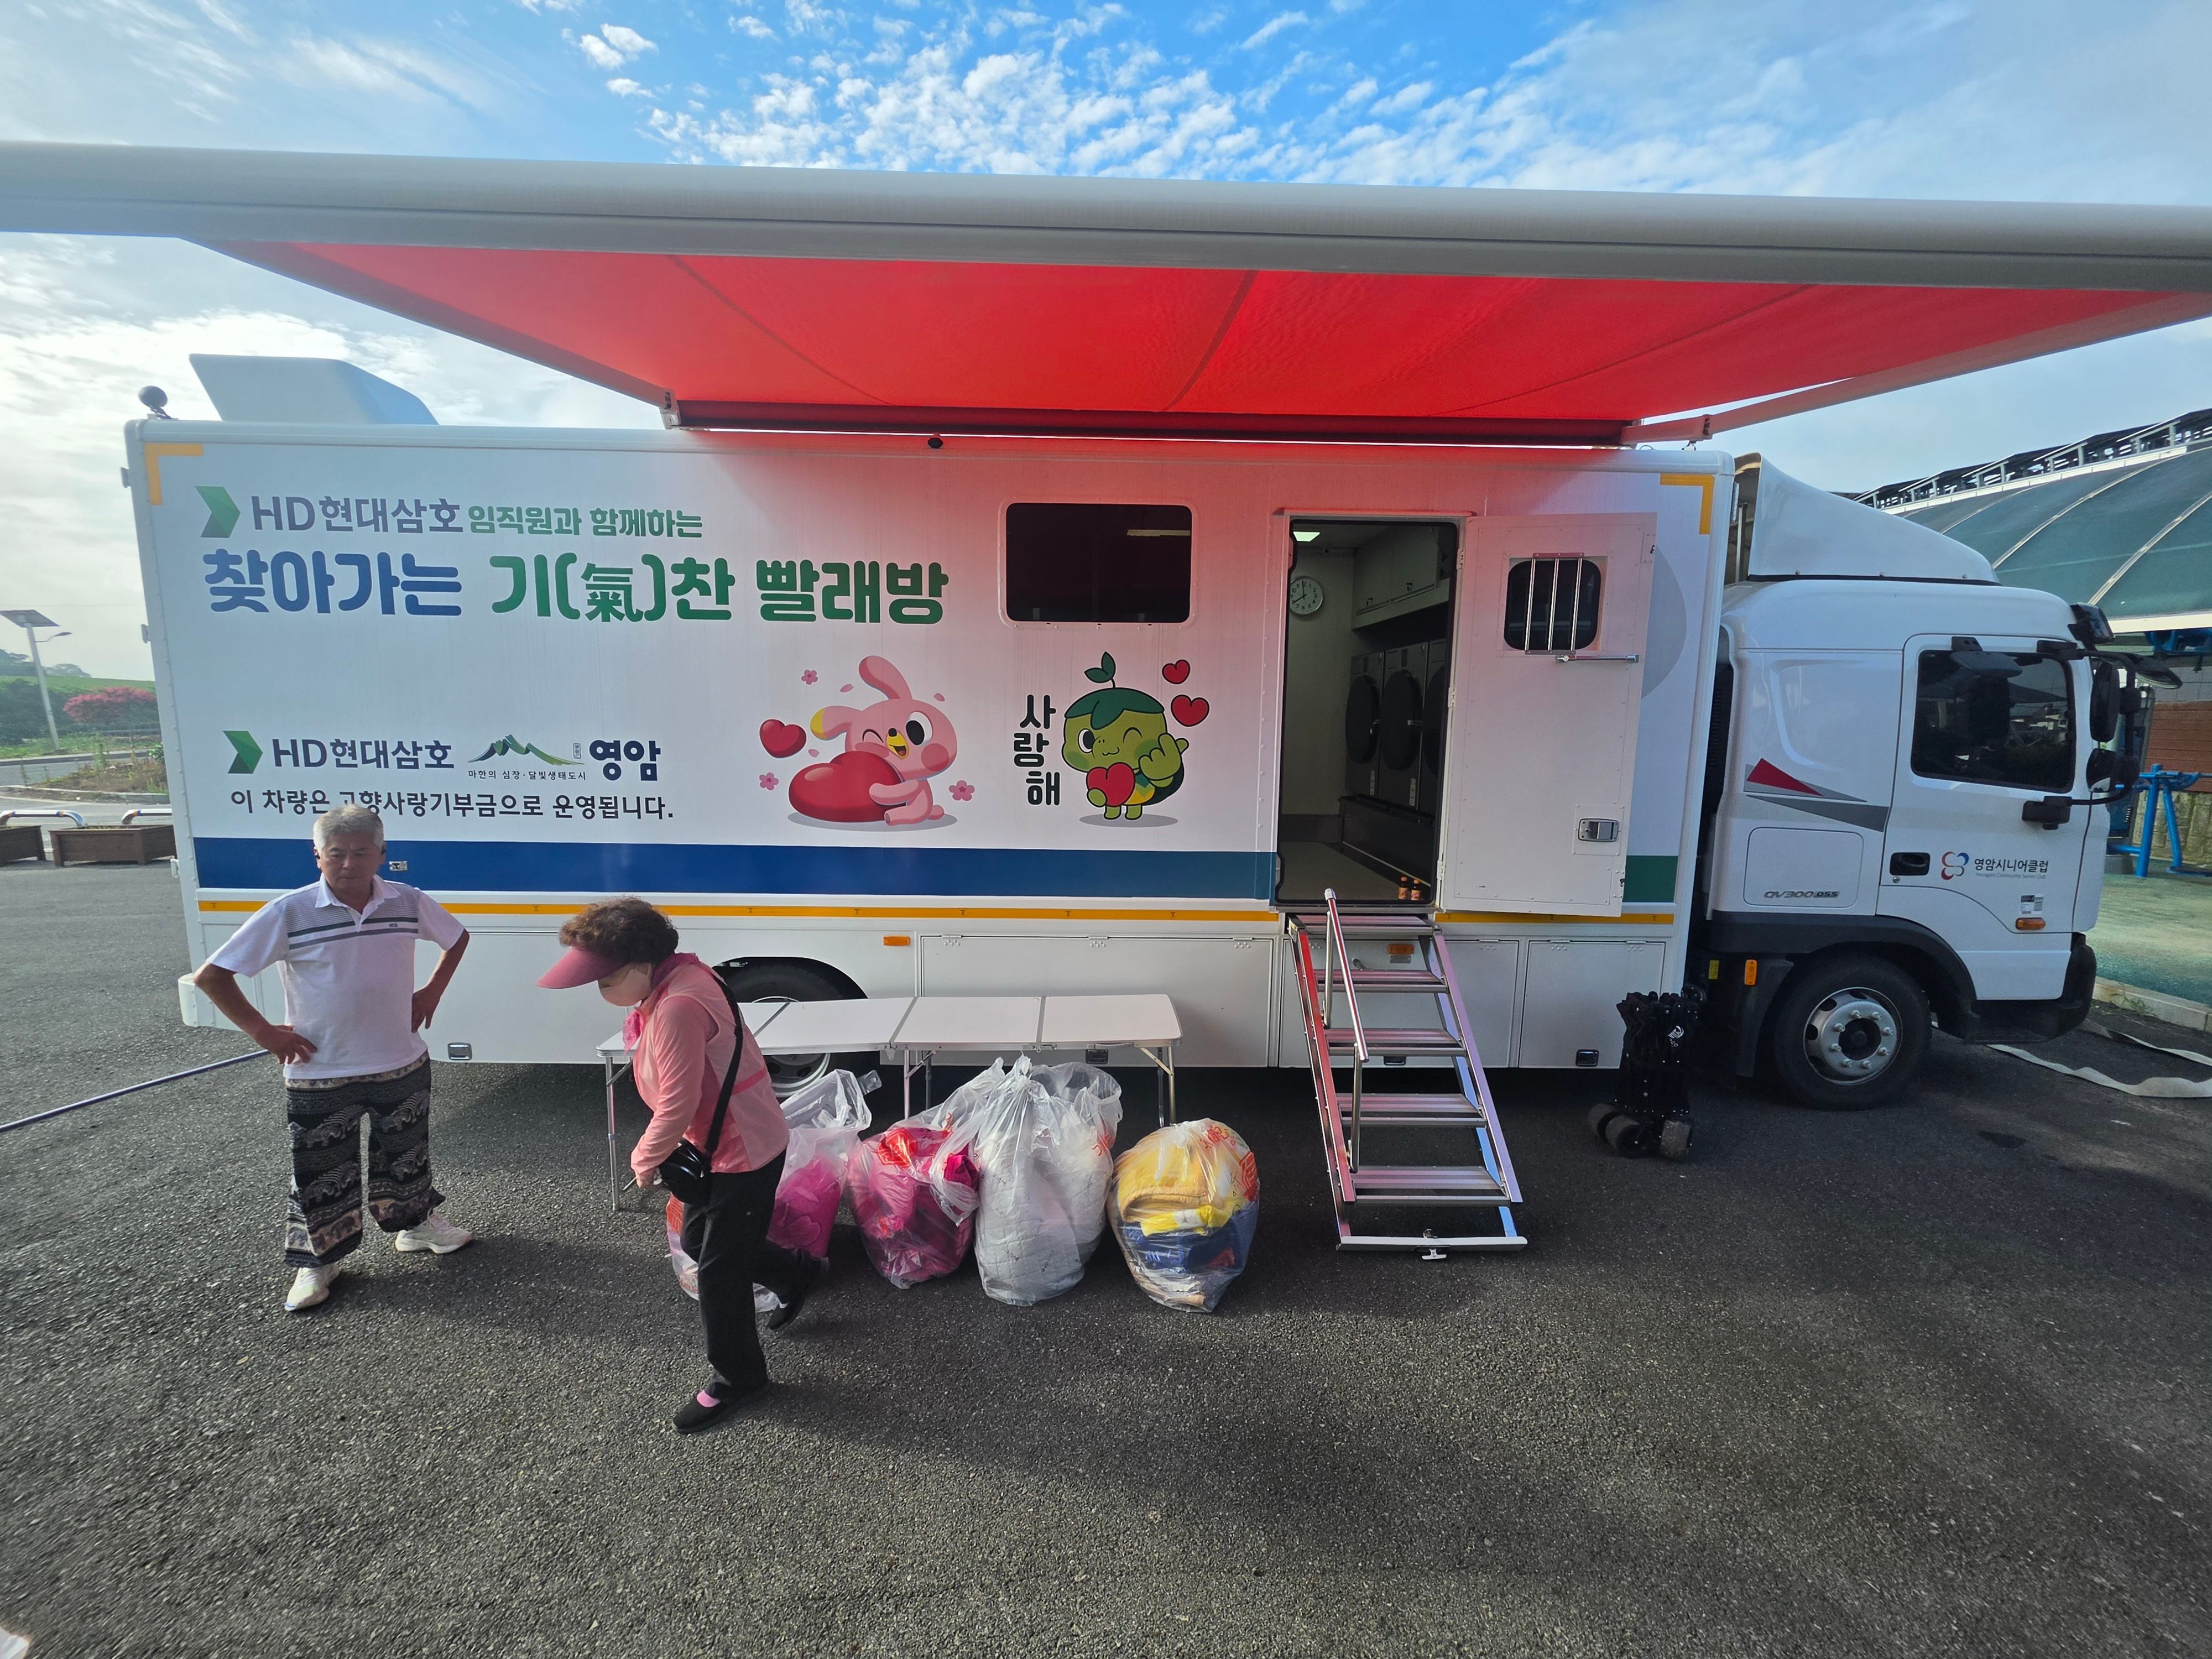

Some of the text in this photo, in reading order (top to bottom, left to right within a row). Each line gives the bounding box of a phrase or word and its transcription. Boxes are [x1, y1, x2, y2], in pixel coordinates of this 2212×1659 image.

[252, 495, 703, 538] HD현대삼호 임직원과 함께하는
[203, 548, 950, 624] 찾아가는 기(氣)찬 빨래방
[272, 739, 455, 769] HD현대삼호
[589, 740, 661, 781] 영암
[1014, 694, 1060, 806] 사랑해
[468, 770, 496, 779] 마한의
[231, 790, 253, 813] 이
[262, 790, 330, 815] 차량은
[552, 795, 674, 820] 운영됩니다.
[1974, 858, 2048, 873] 영암시니어클럽
